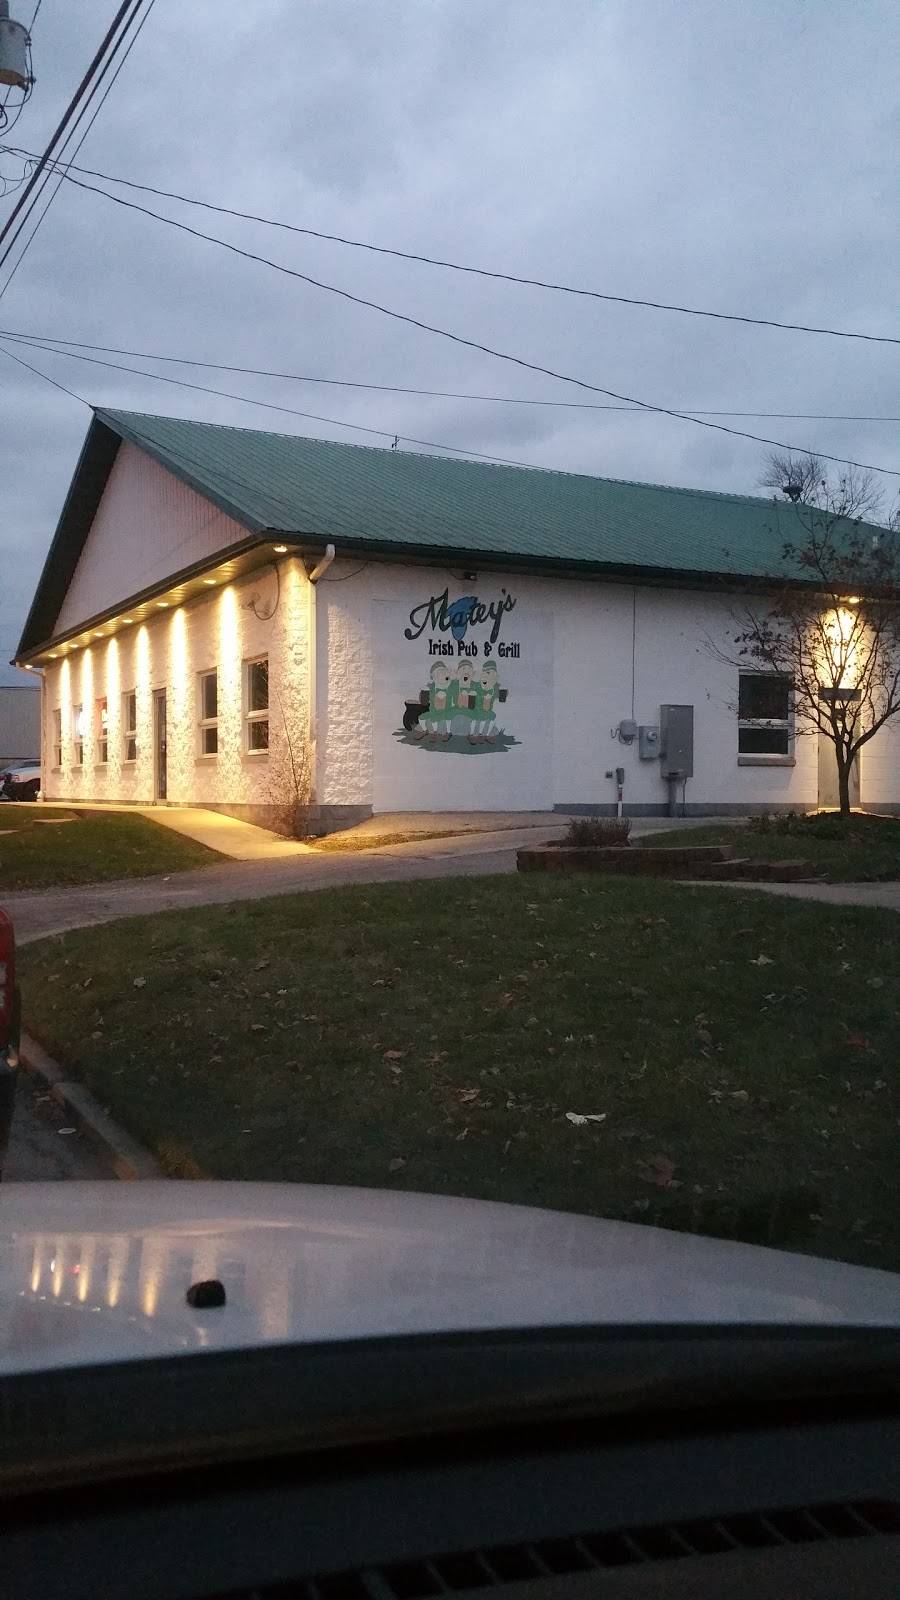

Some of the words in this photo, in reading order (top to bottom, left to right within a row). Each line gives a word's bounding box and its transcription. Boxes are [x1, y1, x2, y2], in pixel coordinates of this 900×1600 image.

[404, 587, 517, 643] Matey's
[428, 639, 454, 656] Irish
[457, 640, 478, 656] Pub
[484, 641, 492, 657] &
[498, 642, 520, 658] Grill
